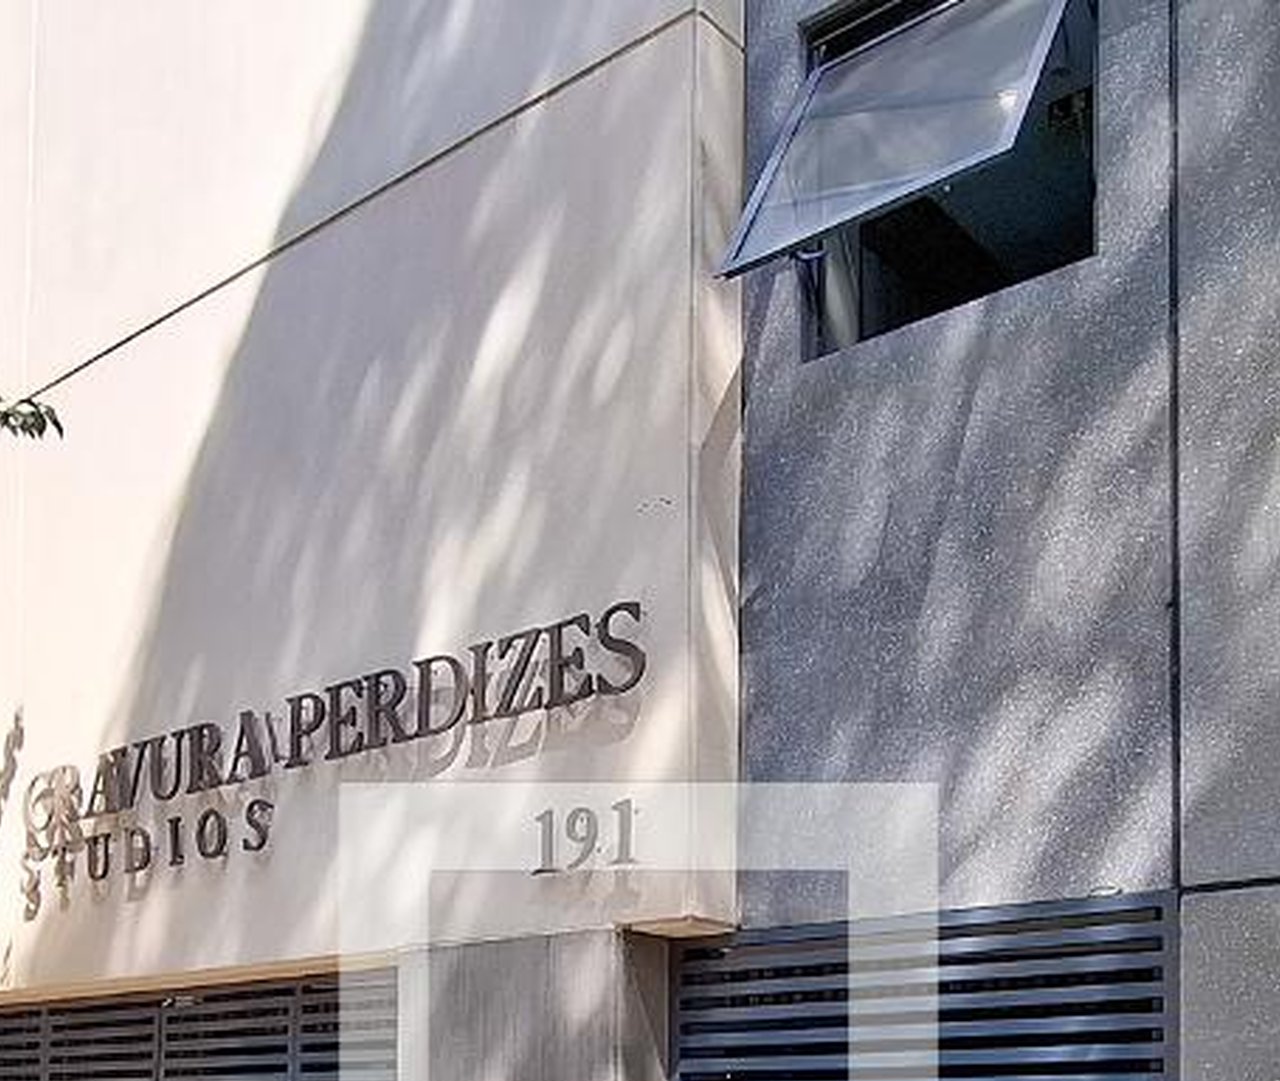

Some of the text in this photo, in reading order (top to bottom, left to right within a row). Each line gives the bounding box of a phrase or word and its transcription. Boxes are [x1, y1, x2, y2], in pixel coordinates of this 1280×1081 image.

[284, 601, 647, 770] PERDIZES
[21, 798, 274, 904] STUDIOS
[531, 798, 635, 876] 191
